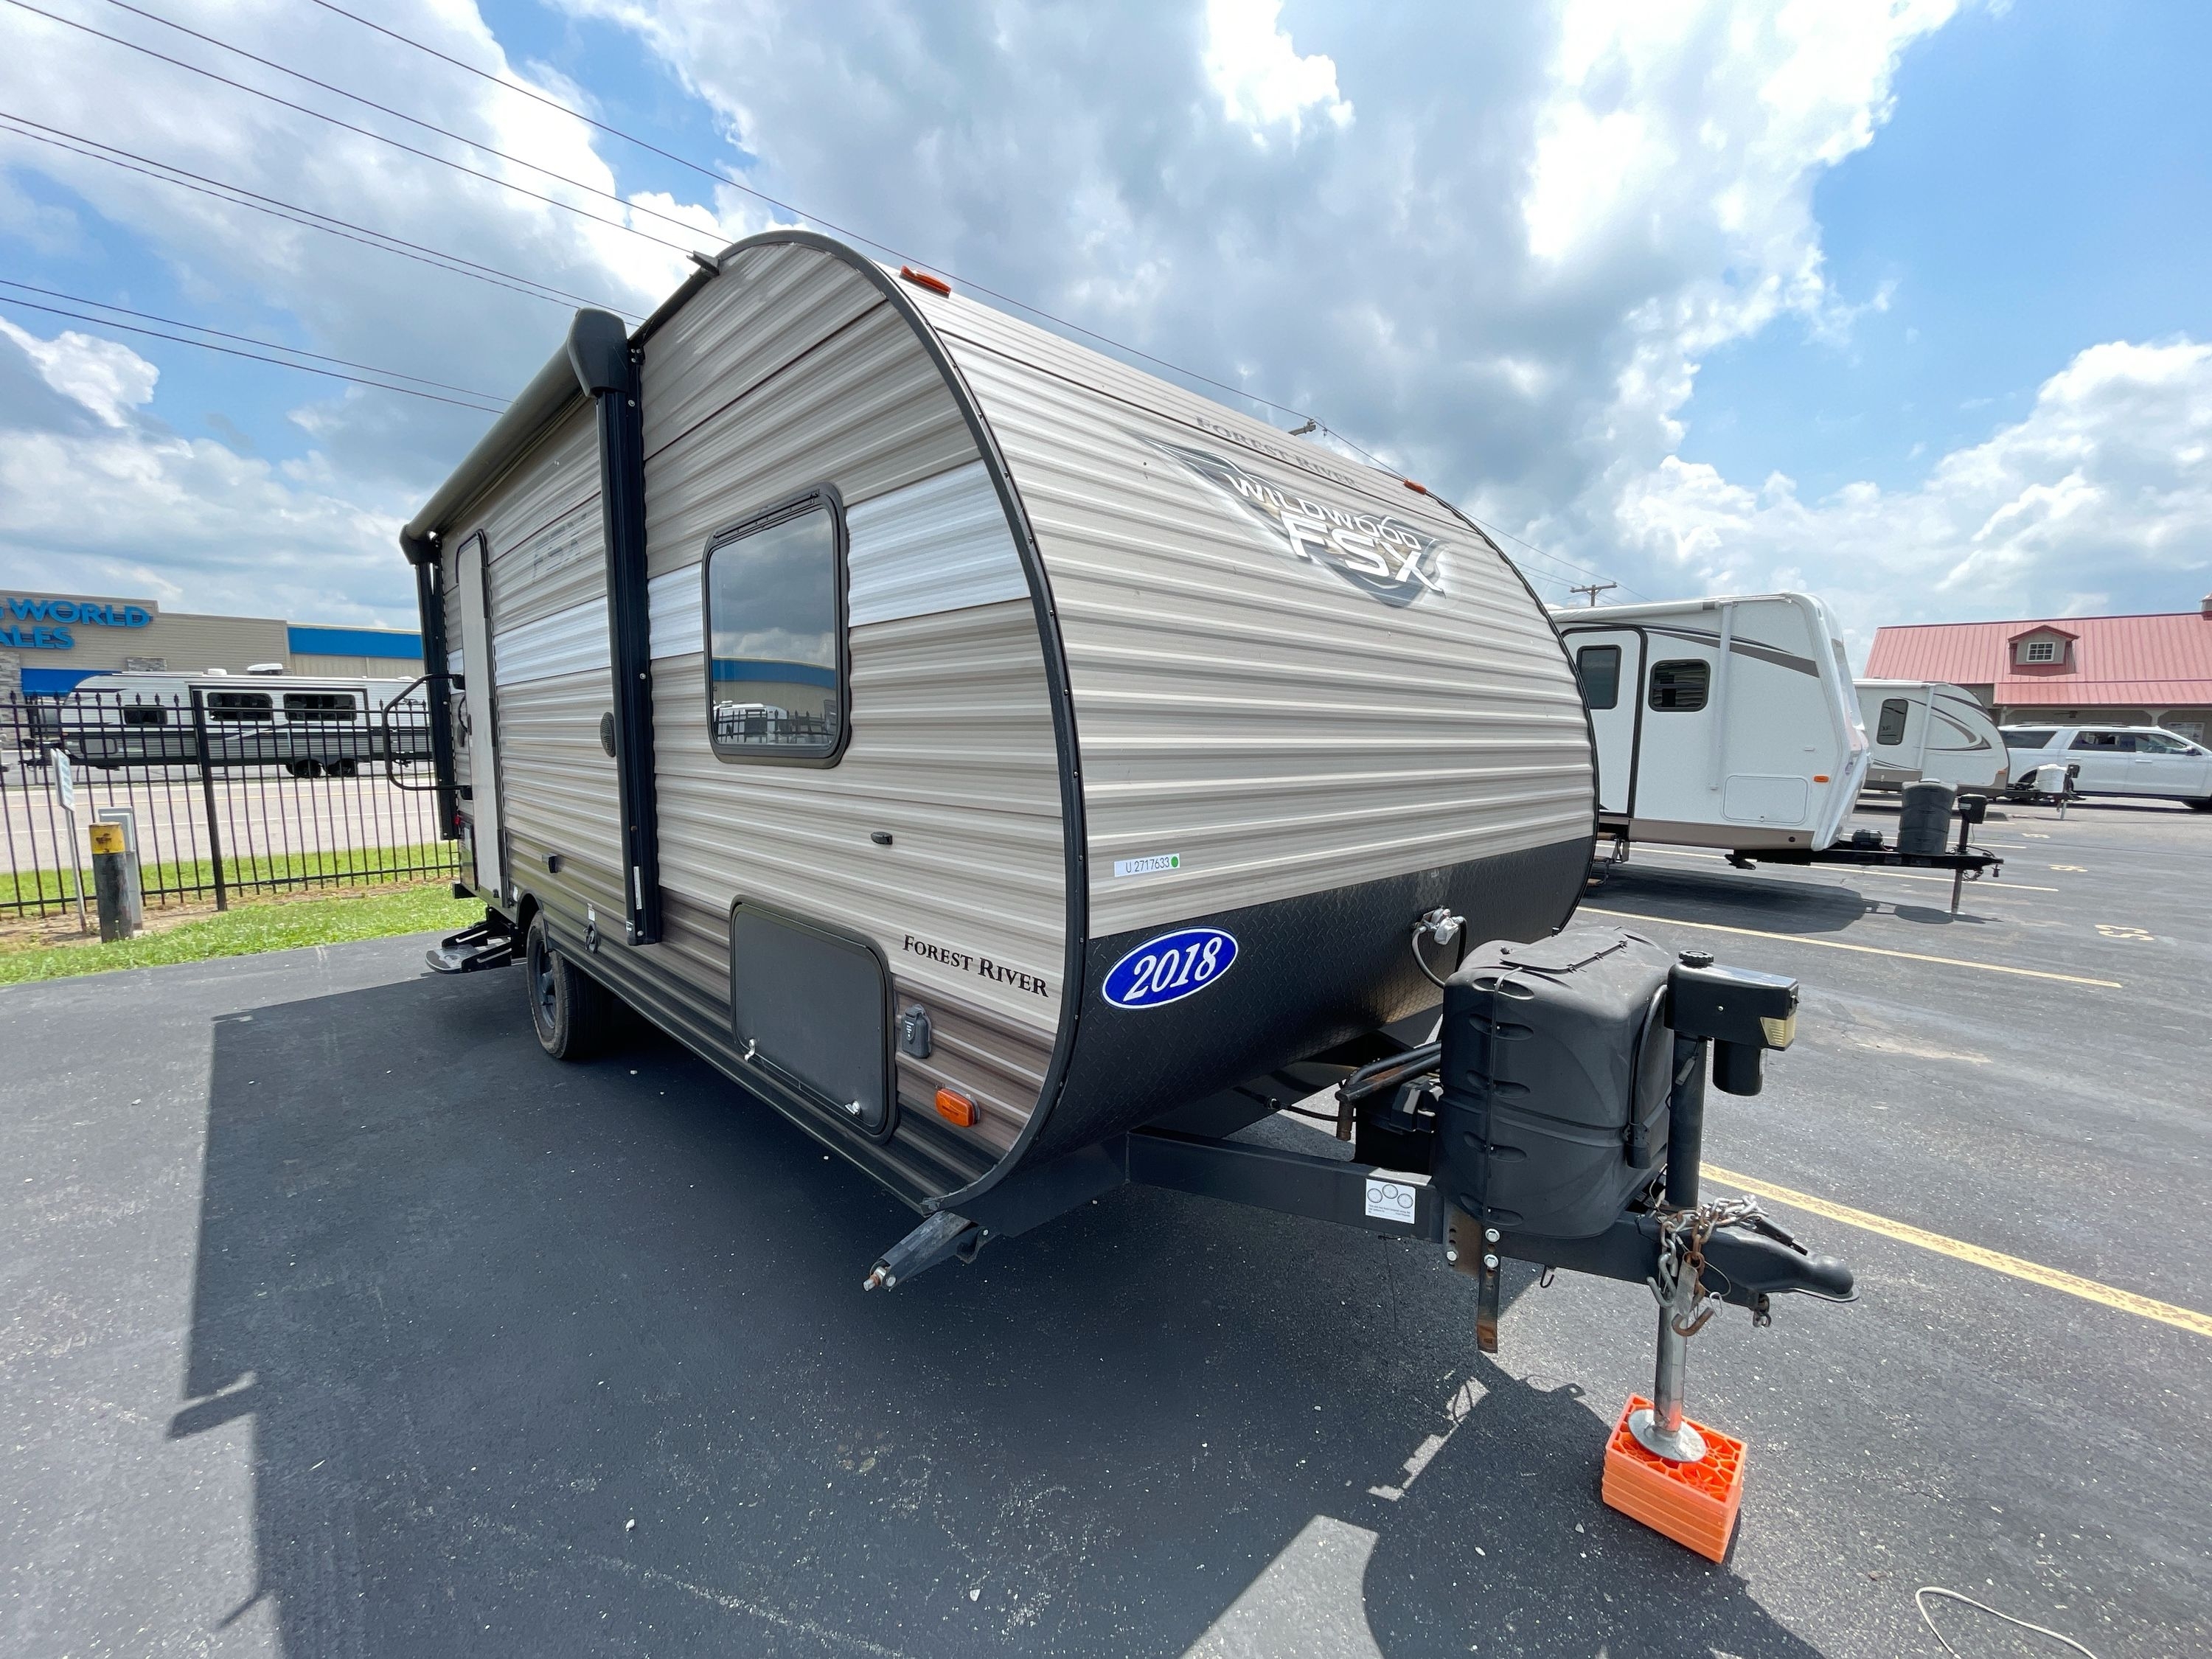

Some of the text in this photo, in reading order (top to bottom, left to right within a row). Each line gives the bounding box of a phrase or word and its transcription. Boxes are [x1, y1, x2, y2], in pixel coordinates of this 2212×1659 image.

[1195, 417, 1360, 489] FOREST RIVER
[1220, 472, 1422, 550] WILDWOOD
[1280, 510, 1444, 592] FSX
[7, 598, 152, 627] WORLD
[1135, 857, 1170, 872] 2717633
[902, 934, 1049, 998] FOREST RIVER
[1123, 936, 1222, 1002] 2018
